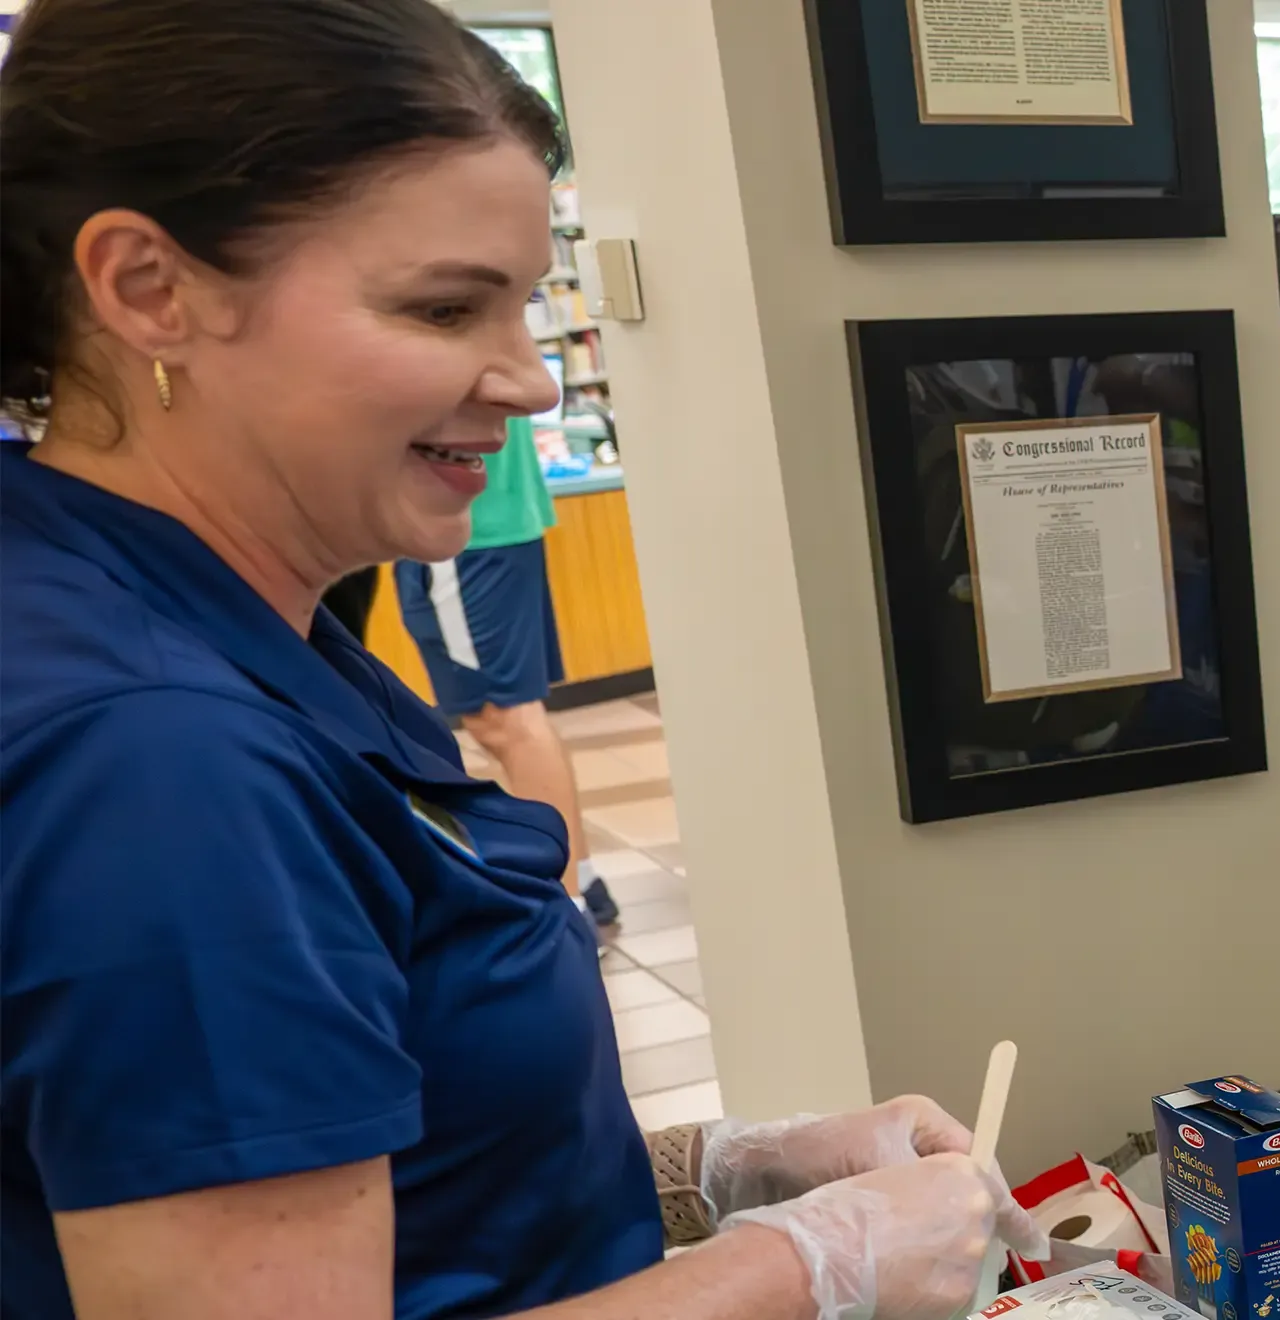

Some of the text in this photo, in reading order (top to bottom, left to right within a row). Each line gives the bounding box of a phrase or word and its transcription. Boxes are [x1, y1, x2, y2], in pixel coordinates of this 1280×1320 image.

[1002, 433, 1146, 459] Congressional Record
[1002, 480, 1125, 497] House of Representatives
[1183, 1129, 1203, 1145] Barilla
[1173, 1145, 1214, 1177] Delicious
[1177, 1164, 1201, 1190] Every
[1204, 1178, 1226, 1200] Bite.
